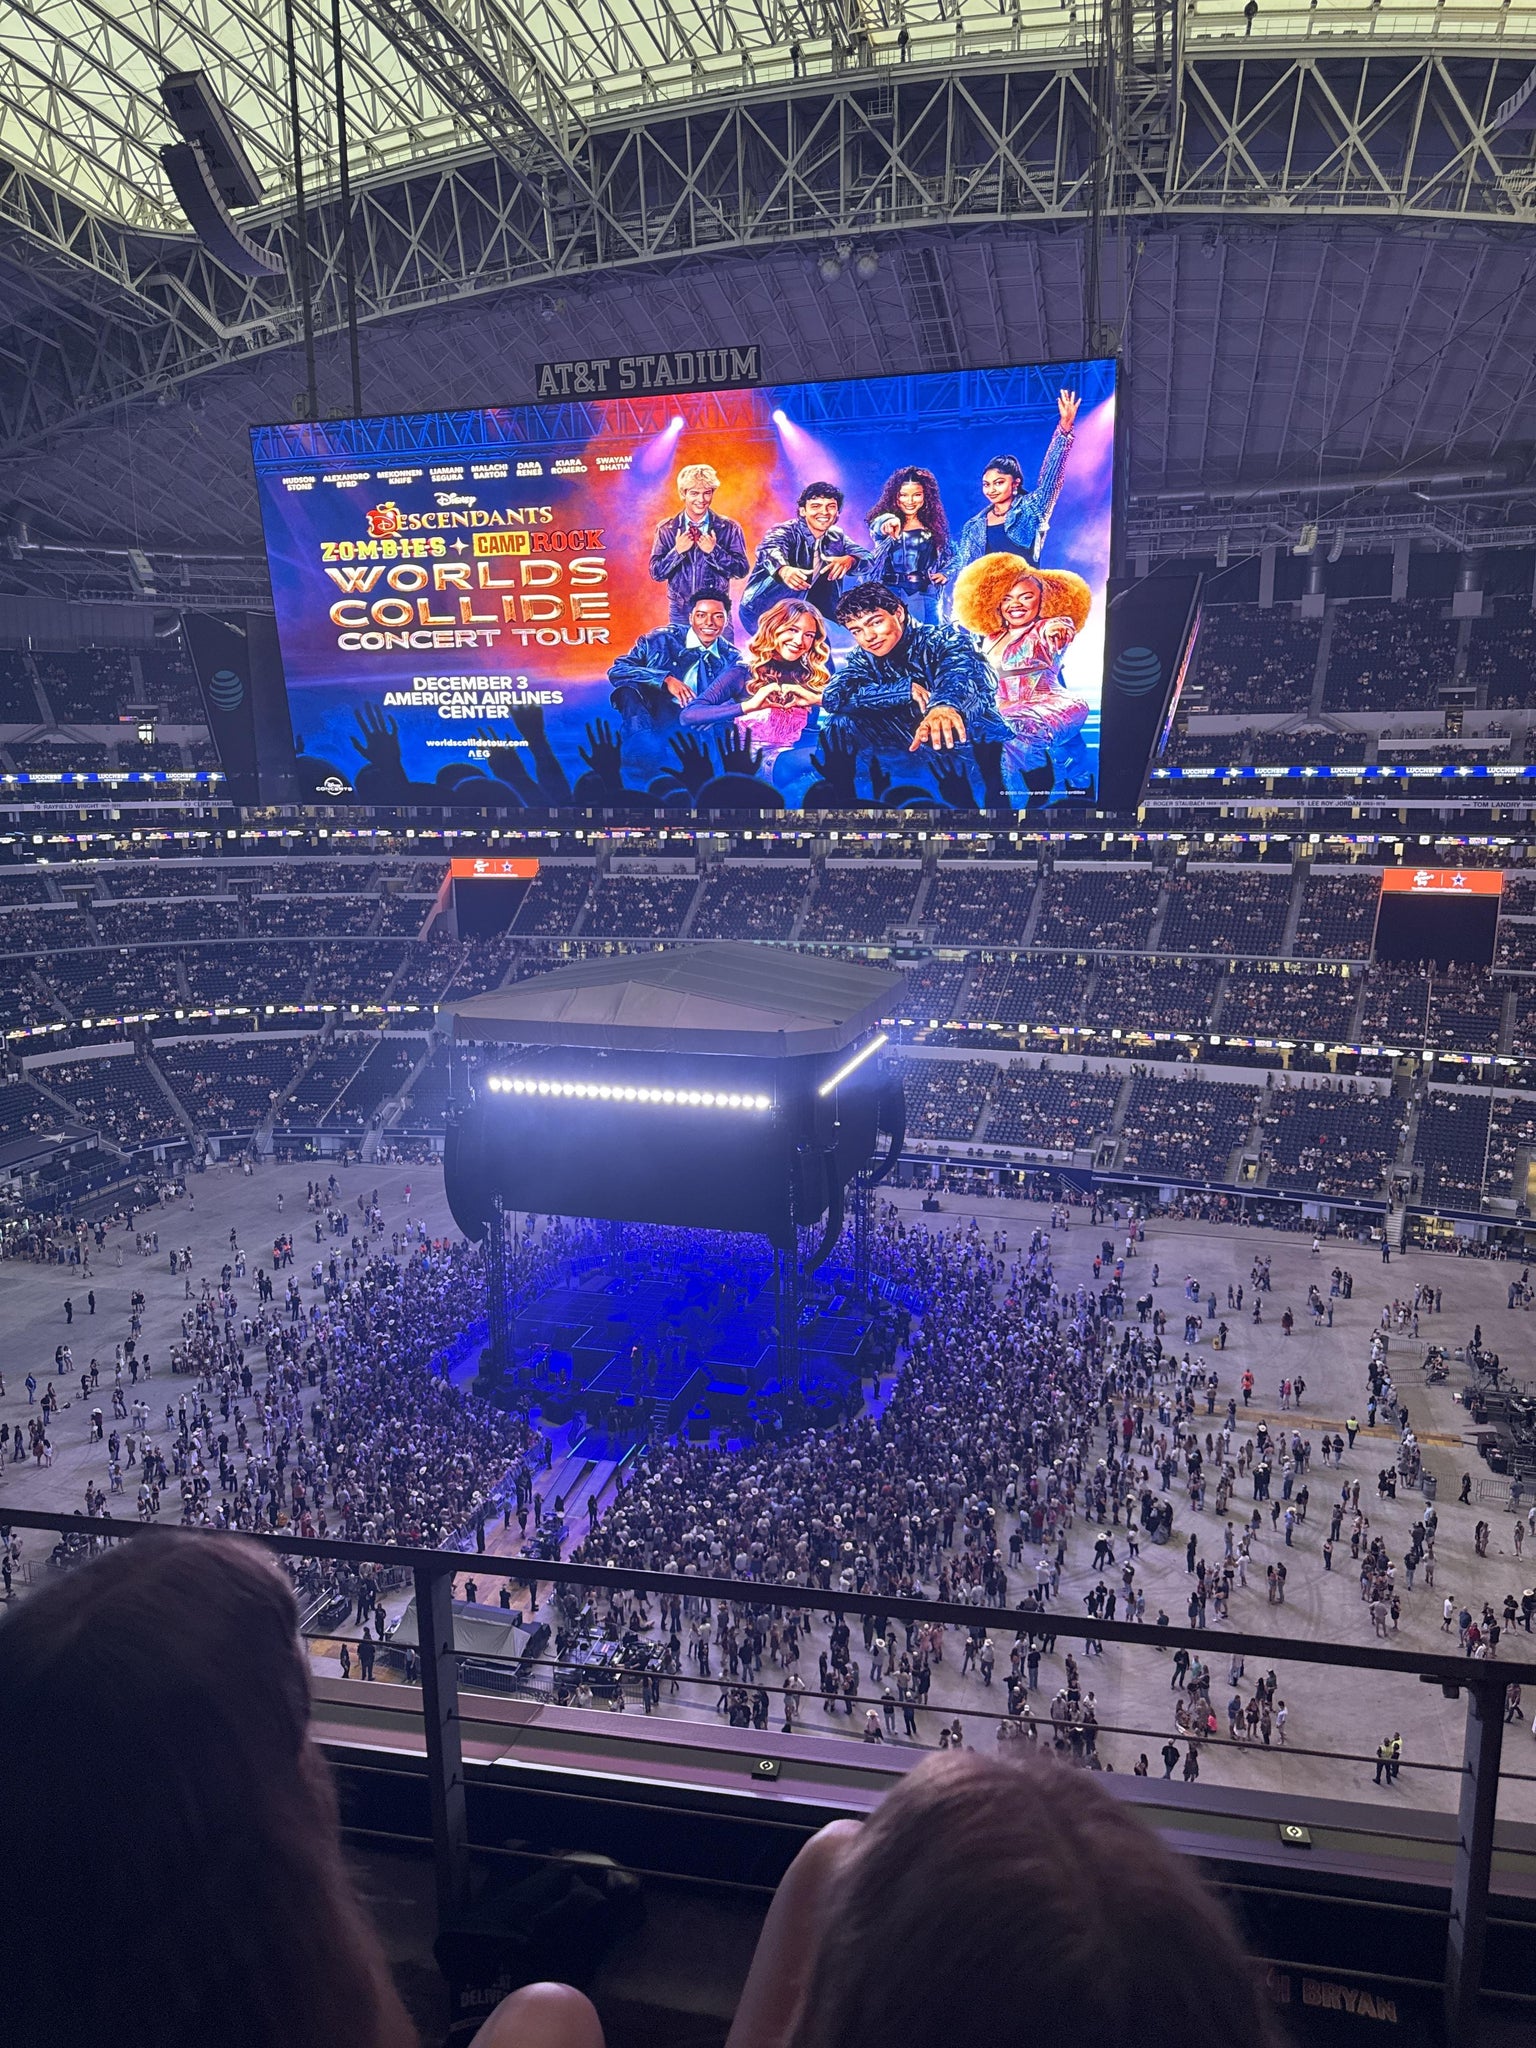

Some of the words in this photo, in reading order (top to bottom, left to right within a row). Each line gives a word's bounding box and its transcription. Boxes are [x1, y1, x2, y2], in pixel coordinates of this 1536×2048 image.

[538, 360, 610, 396] AT&T
[618, 347, 758, 391] STADIUM
[555, 458, 582, 467] KIARA
[596, 455, 633, 465] SWAYAM
[471, 463, 509, 473] MALACHI
[517, 461, 542, 470] DARA
[551, 465, 588, 475] ROMERO
[599, 462, 631, 472] BHATIA
[377, 469, 423, 479] MEKONNEN
[429, 466, 464, 476] LIAMANI
[473, 471, 508, 480] BARTON
[282, 476, 316, 486] HUDSON
[323, 473, 370, 483] ALEXANDRO
[389, 477, 413, 485] KNIFE
[431, 473, 464, 482] SEGURA
[287, 483, 313, 492] STONE
[336, 481, 358, 489] BYRD
[433, 492, 477, 508] Disney
[367, 507, 553, 538] DESCENDANTS
[320, 537, 447, 562] ZOMBIES
[477, 534, 526, 554] CAMP
[531, 529, 606, 553] ROCK
[324, 557, 609, 594] WORLDS
[329, 592, 612, 627] COLLIDE
[337, 629, 501, 651] CONCERT
[511, 627, 611, 646] TOUR
[413, 676, 513, 691] DECEMBER
[516, 676, 528, 689] 3
[383, 691, 480, 706] AMERICAN
[481, 690, 564, 705] AIRLINES
[437, 705, 510, 719] CENTER
[426, 738, 529, 748] worldscollidetour.com
[468, 750, 491, 758] AEG
[1302, 1977, 1398, 2023] BRYAN
